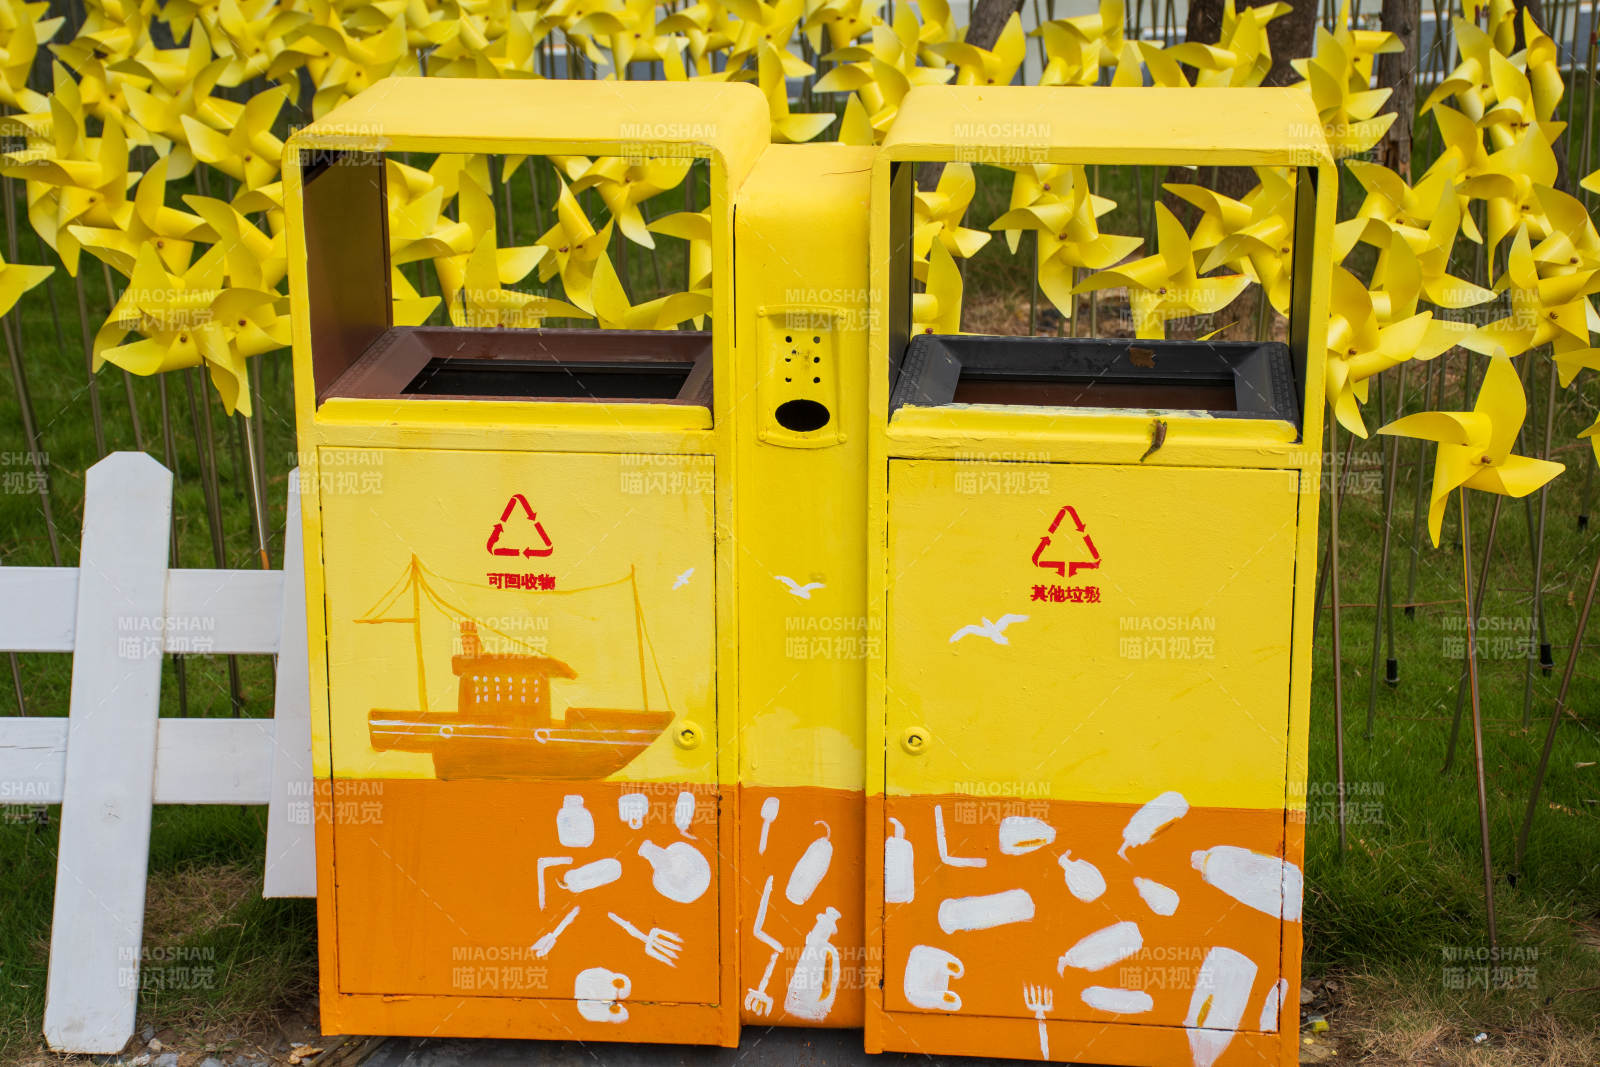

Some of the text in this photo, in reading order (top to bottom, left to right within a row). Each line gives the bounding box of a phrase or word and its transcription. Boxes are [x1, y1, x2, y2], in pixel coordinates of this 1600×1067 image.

[486, 572, 556, 591] 可回收物
[1030, 584, 1102, 603] 其他垃圾
